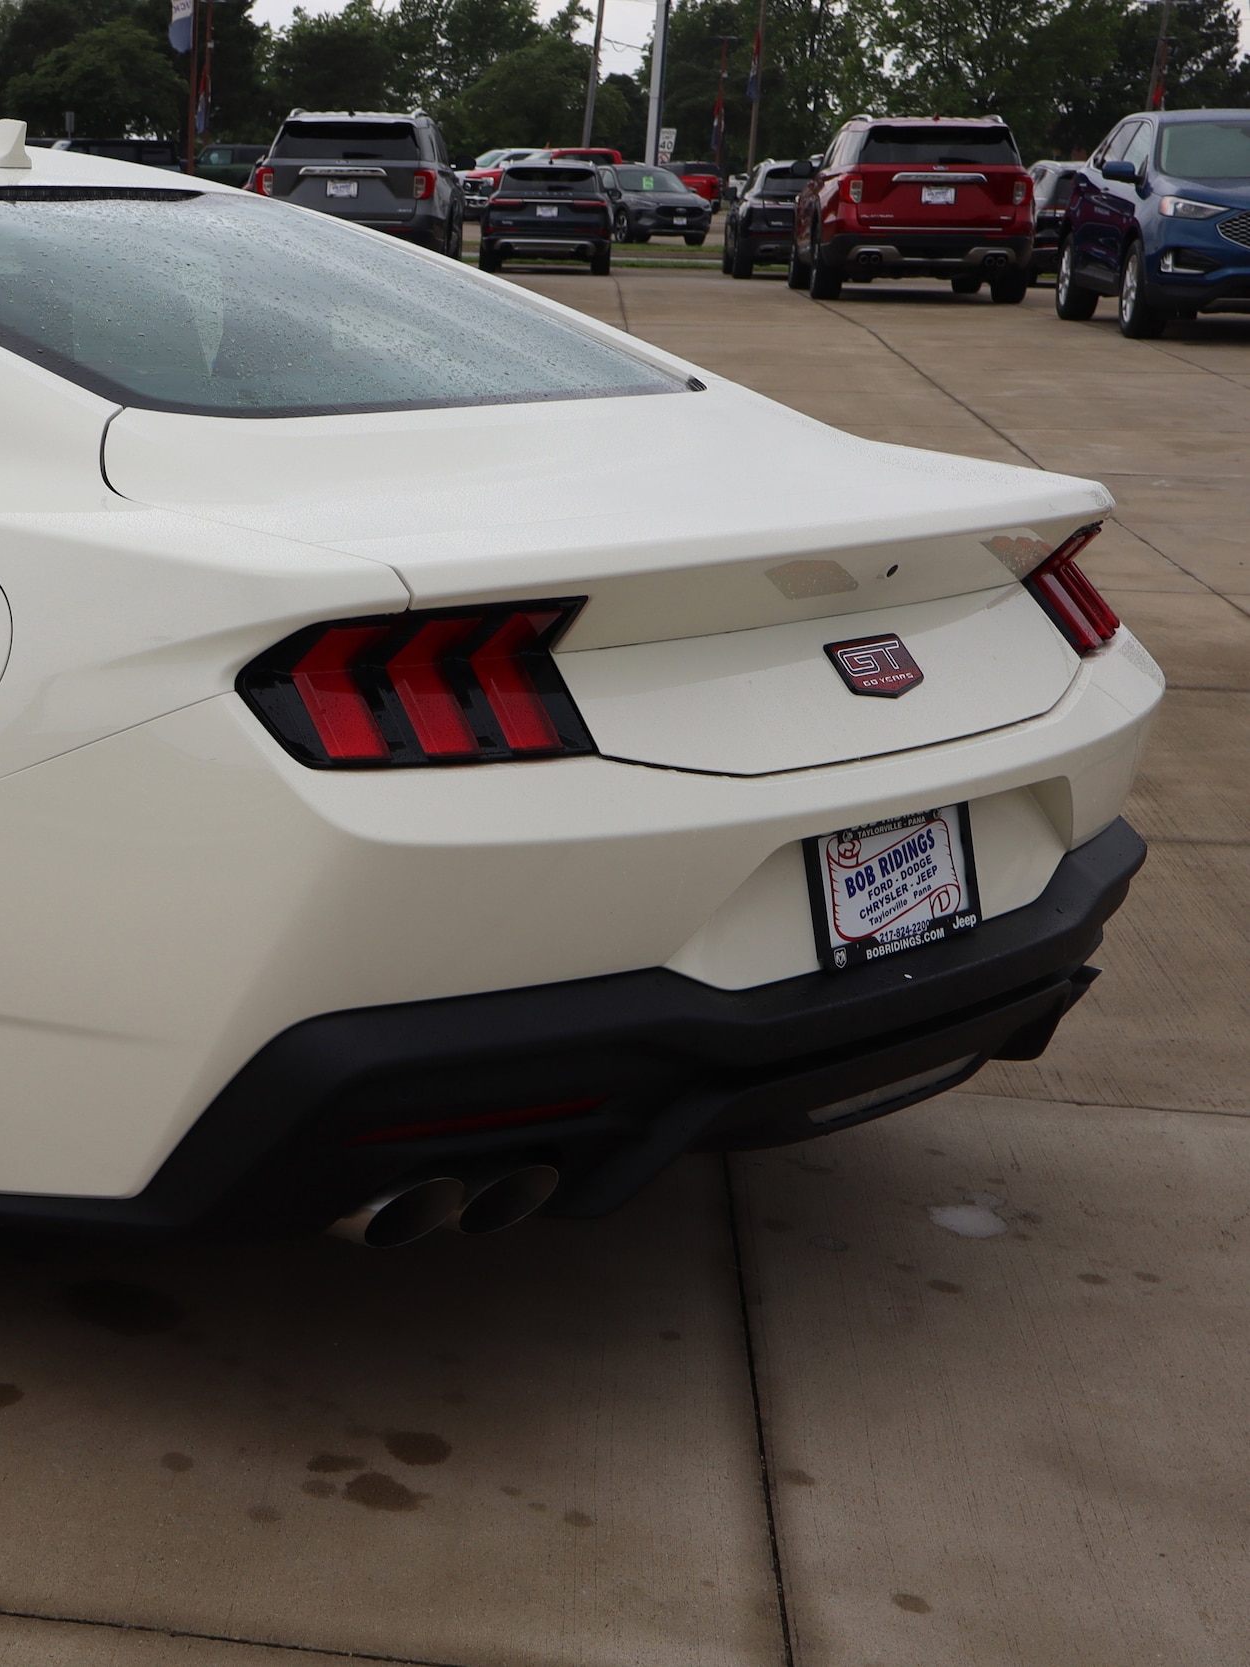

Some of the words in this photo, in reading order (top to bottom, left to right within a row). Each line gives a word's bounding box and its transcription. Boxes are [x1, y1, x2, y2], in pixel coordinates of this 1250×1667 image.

[659, 141, 673, 150] 40
[837, 640, 900, 677] GT
[863, 679, 879, 687] 60
[879, 672, 914, 683] YEARS
[857, 823, 902, 838] TAYLORVILLE
[908, 815, 926, 826] PANA
[844, 864, 876, 899] BOB
[877, 828, 935, 879] RIDINGS
[867, 878, 893, 900] FORD
[900, 854, 933, 880] DODGE
[859, 883, 909, 919] CHRYSLER
[916, 864, 938, 886] JEEP
[868, 899, 908, 926] Taylorville
[913, 884, 932, 899] Pana
[952, 913, 977, 930] Jeep
[865, 927, 946, 960] BOBRIDINGS.COM
